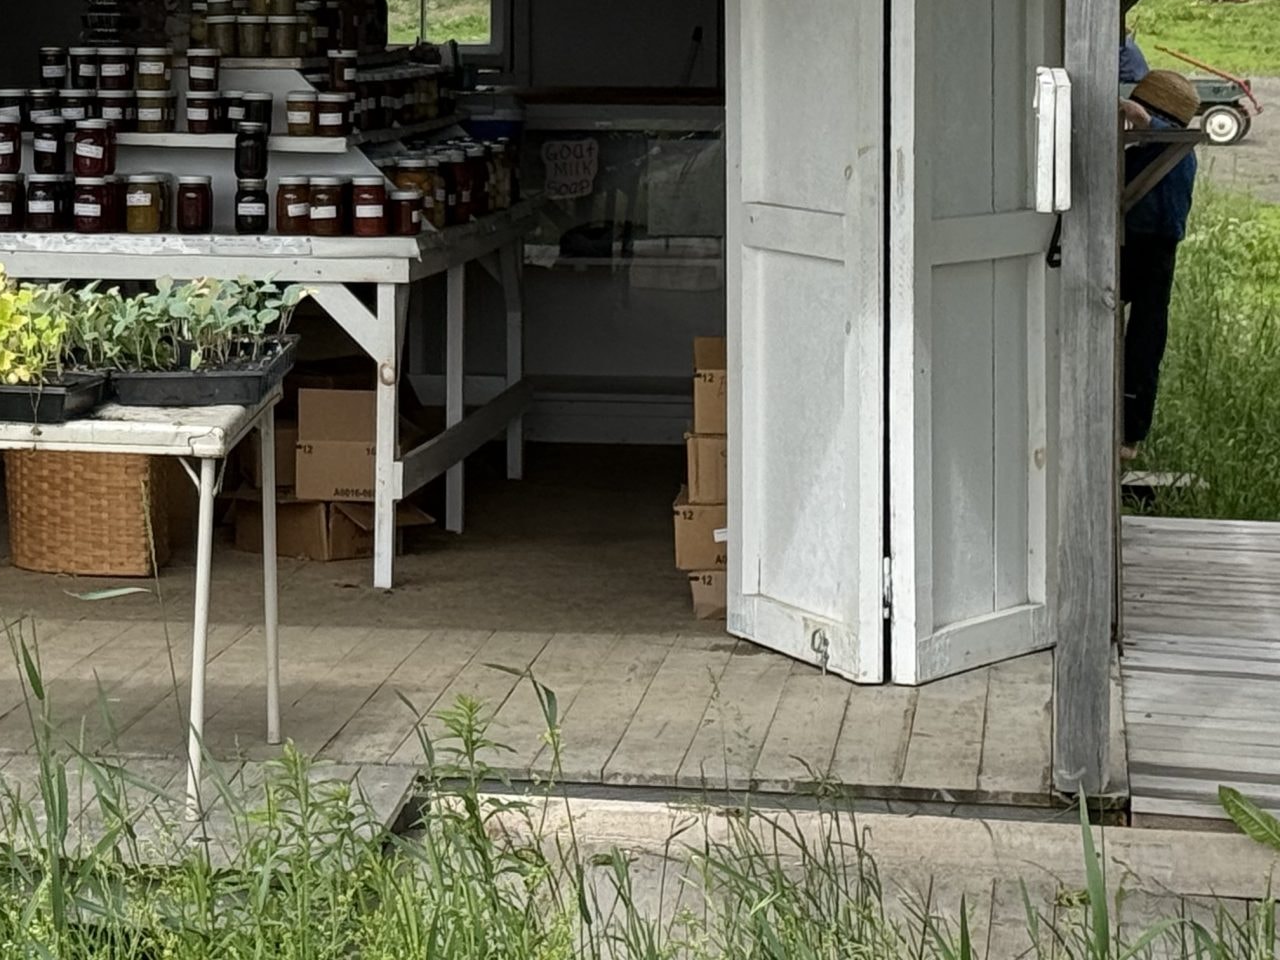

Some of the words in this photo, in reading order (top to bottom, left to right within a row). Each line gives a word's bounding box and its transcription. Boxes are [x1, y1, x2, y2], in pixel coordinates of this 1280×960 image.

[703, 373, 714, 383] 12
[303, 444, 313, 454] 12
[682, 510, 694, 520] 12
[701, 574, 713, 586] 12
